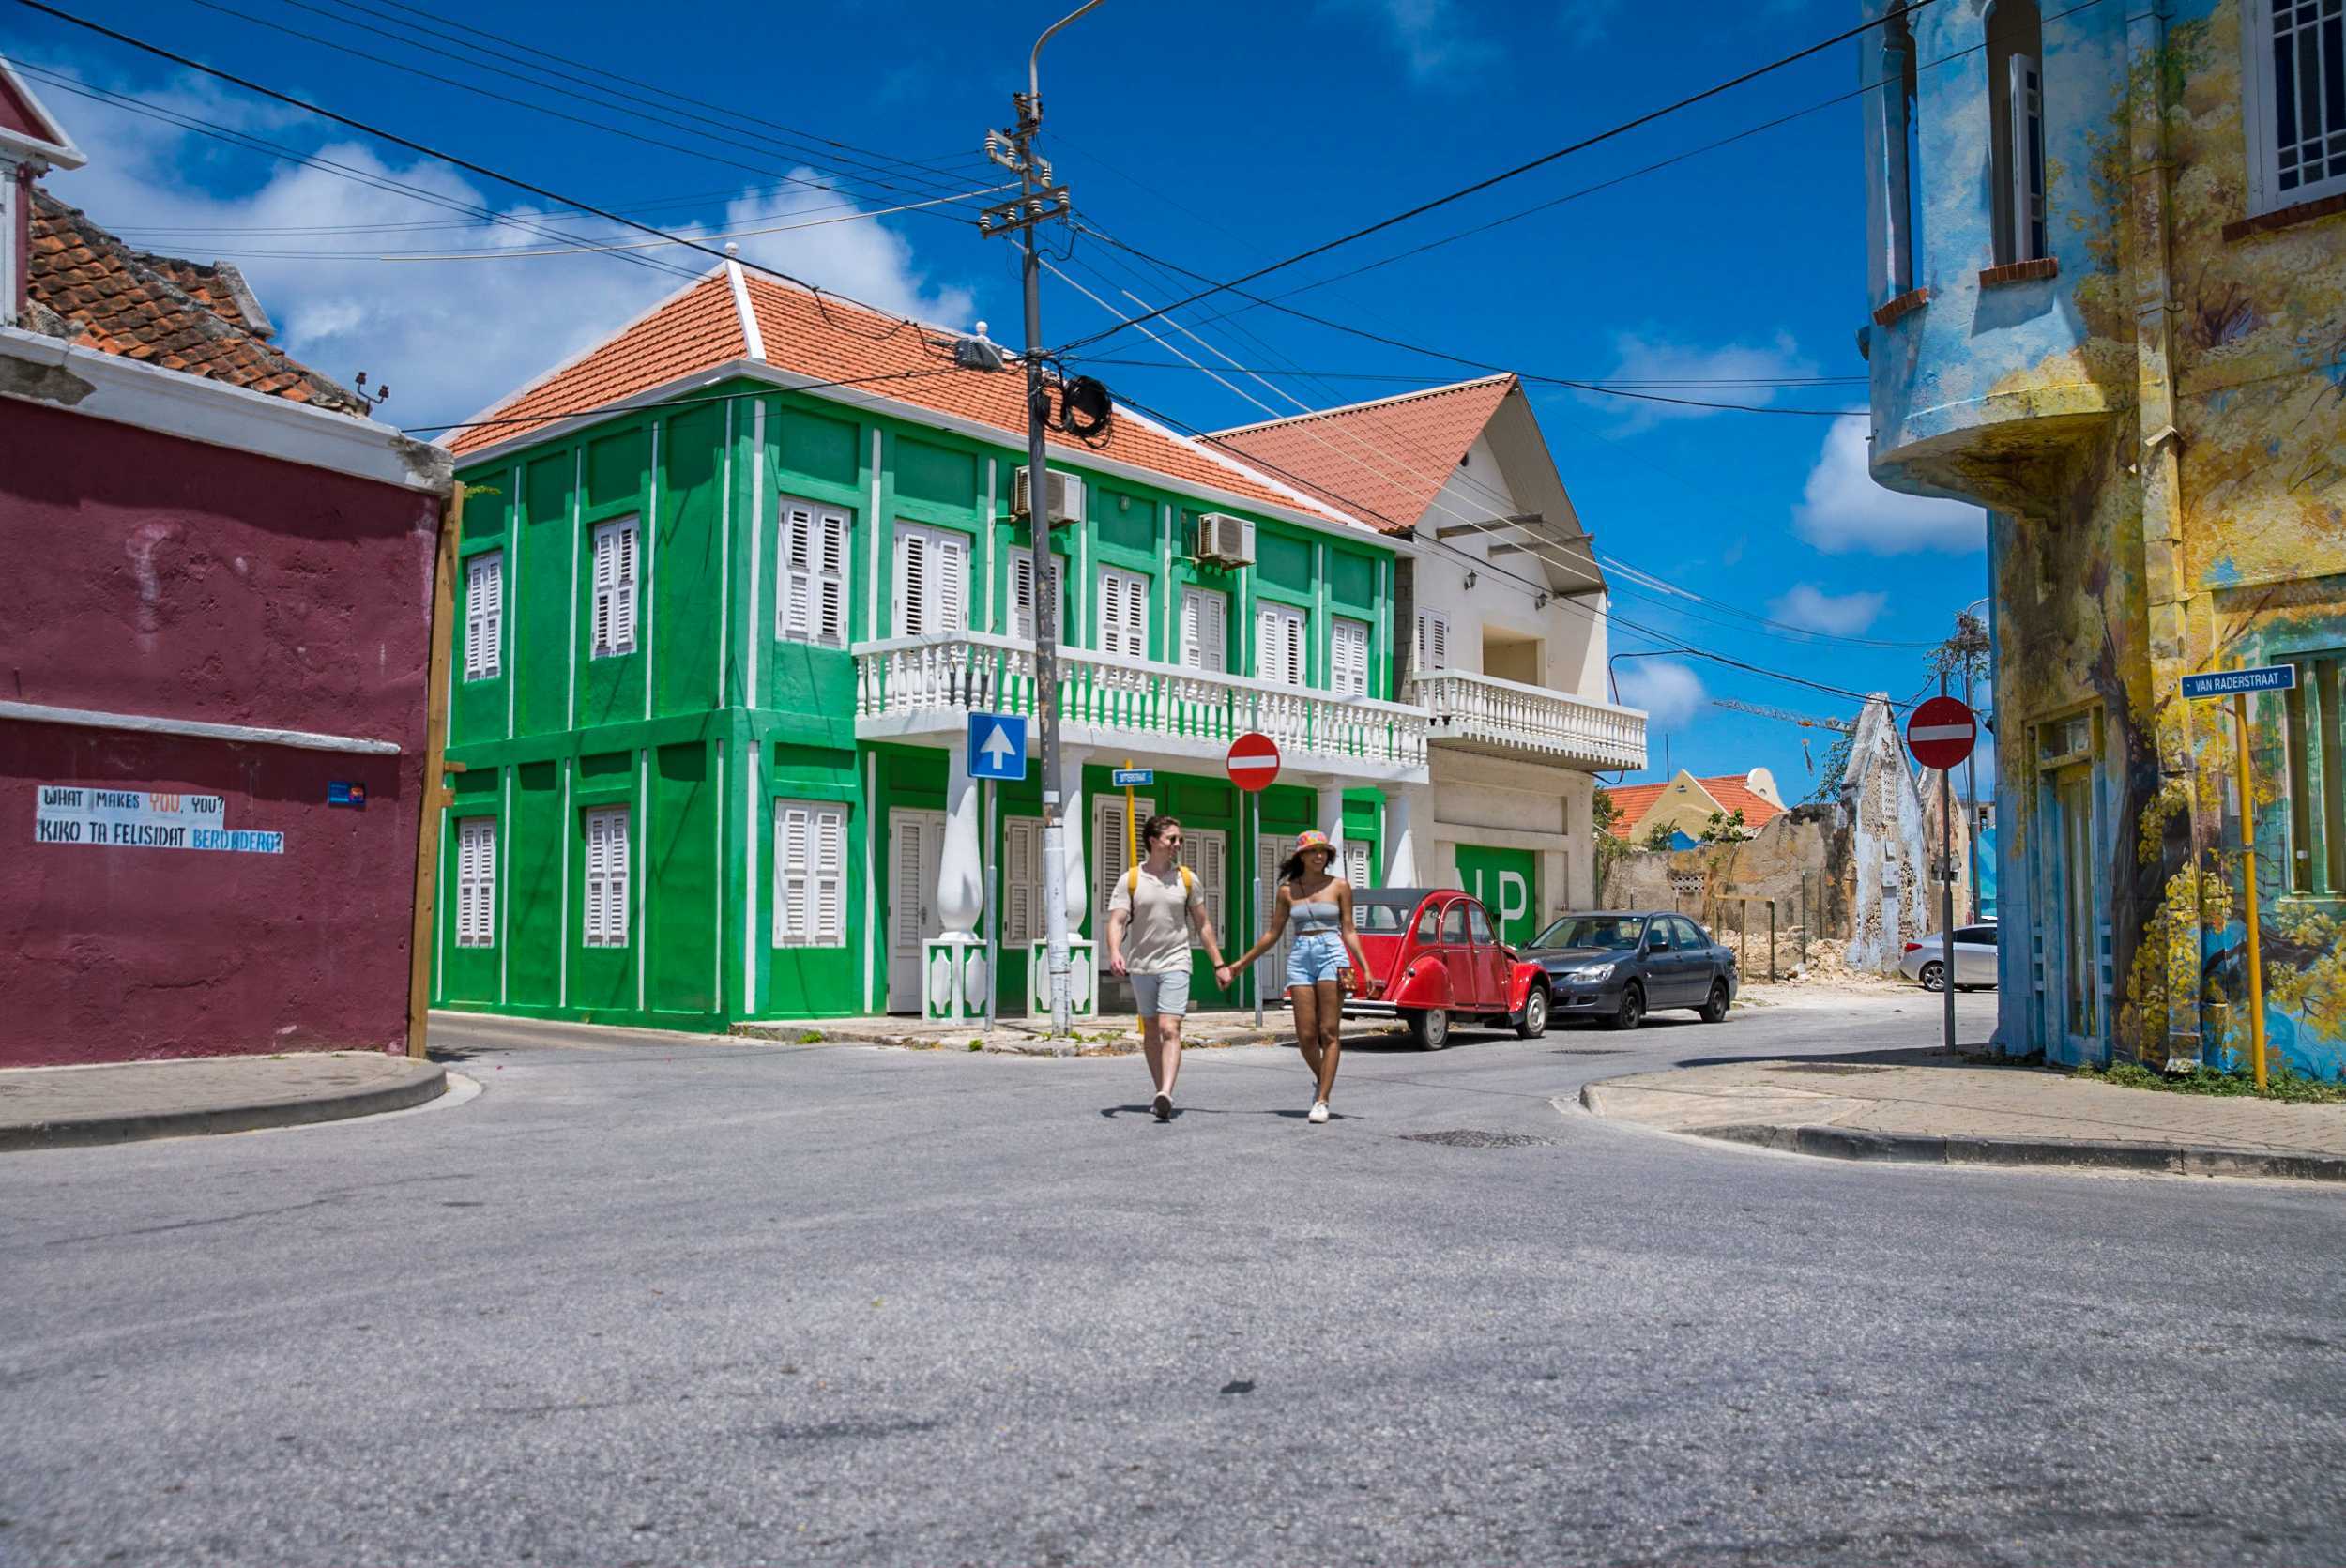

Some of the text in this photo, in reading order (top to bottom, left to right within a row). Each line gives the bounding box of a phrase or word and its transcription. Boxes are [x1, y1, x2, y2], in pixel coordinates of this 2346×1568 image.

[2196, 672, 2279, 693] VAN RADERSTRAAT
[43, 788, 84, 807] WHAT
[96, 791, 141, 809] MAKES
[191, 795, 225, 814] YOU?
[40, 819, 282, 854] KIKO TA FELISIDAT BERDADERO?
